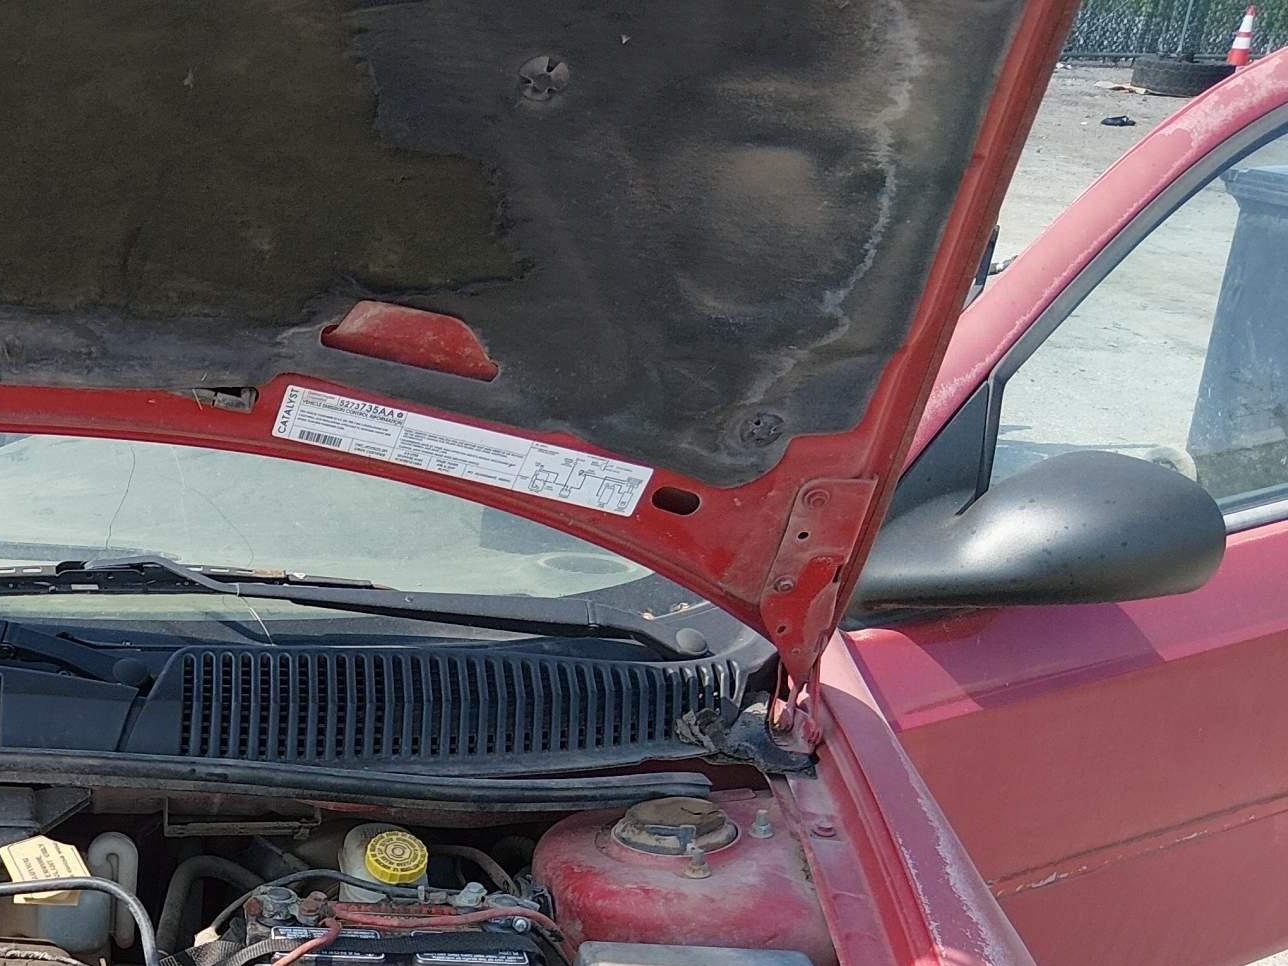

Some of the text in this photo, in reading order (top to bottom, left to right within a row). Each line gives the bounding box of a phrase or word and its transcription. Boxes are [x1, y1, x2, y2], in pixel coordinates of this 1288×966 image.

[277, 387, 300, 434] CATALYST
[339, 399, 395, 418] 5273735AA
[346, 408, 369, 419] CONTROL
